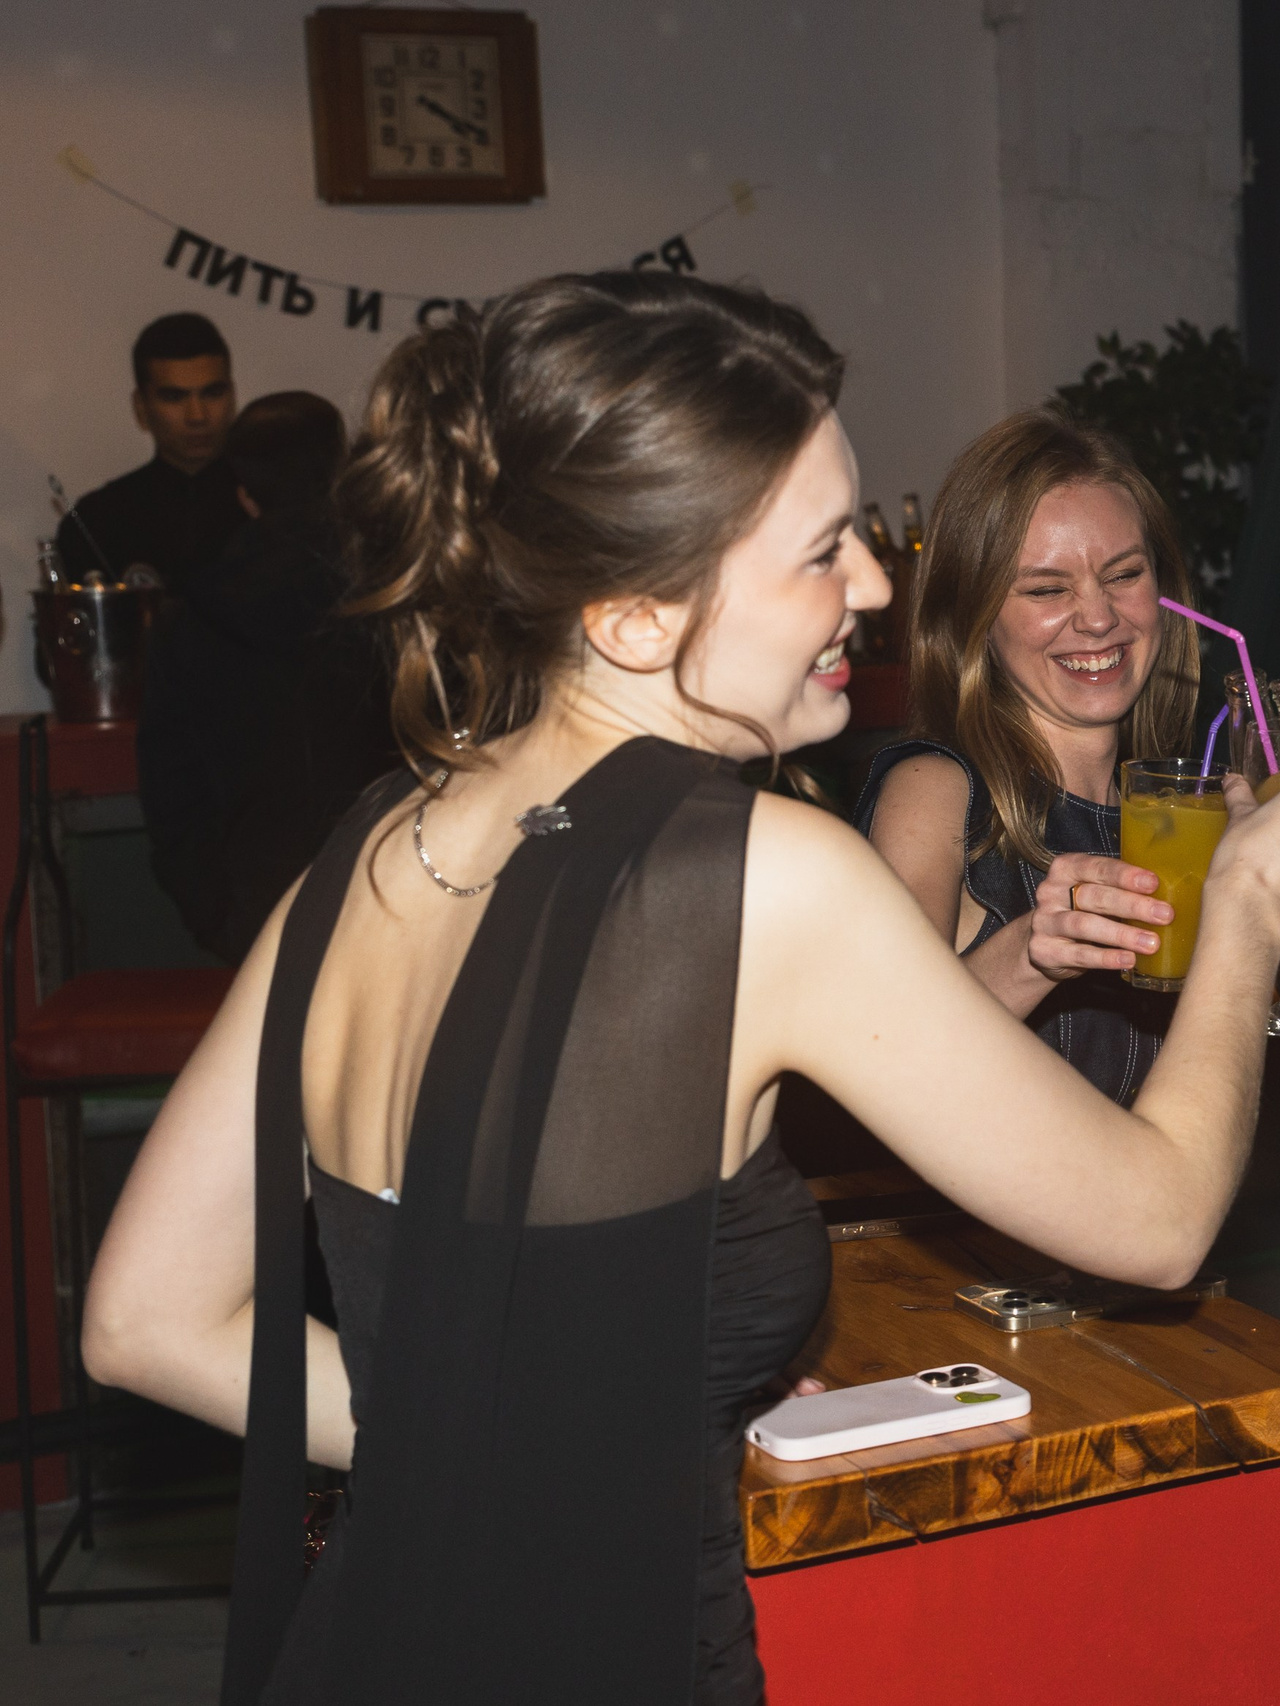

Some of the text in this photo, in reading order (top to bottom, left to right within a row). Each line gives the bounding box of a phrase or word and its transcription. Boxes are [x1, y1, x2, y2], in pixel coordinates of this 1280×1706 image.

[418, 46, 440, 69] 12
[163, 227, 384, 333] ПИТЬ И
